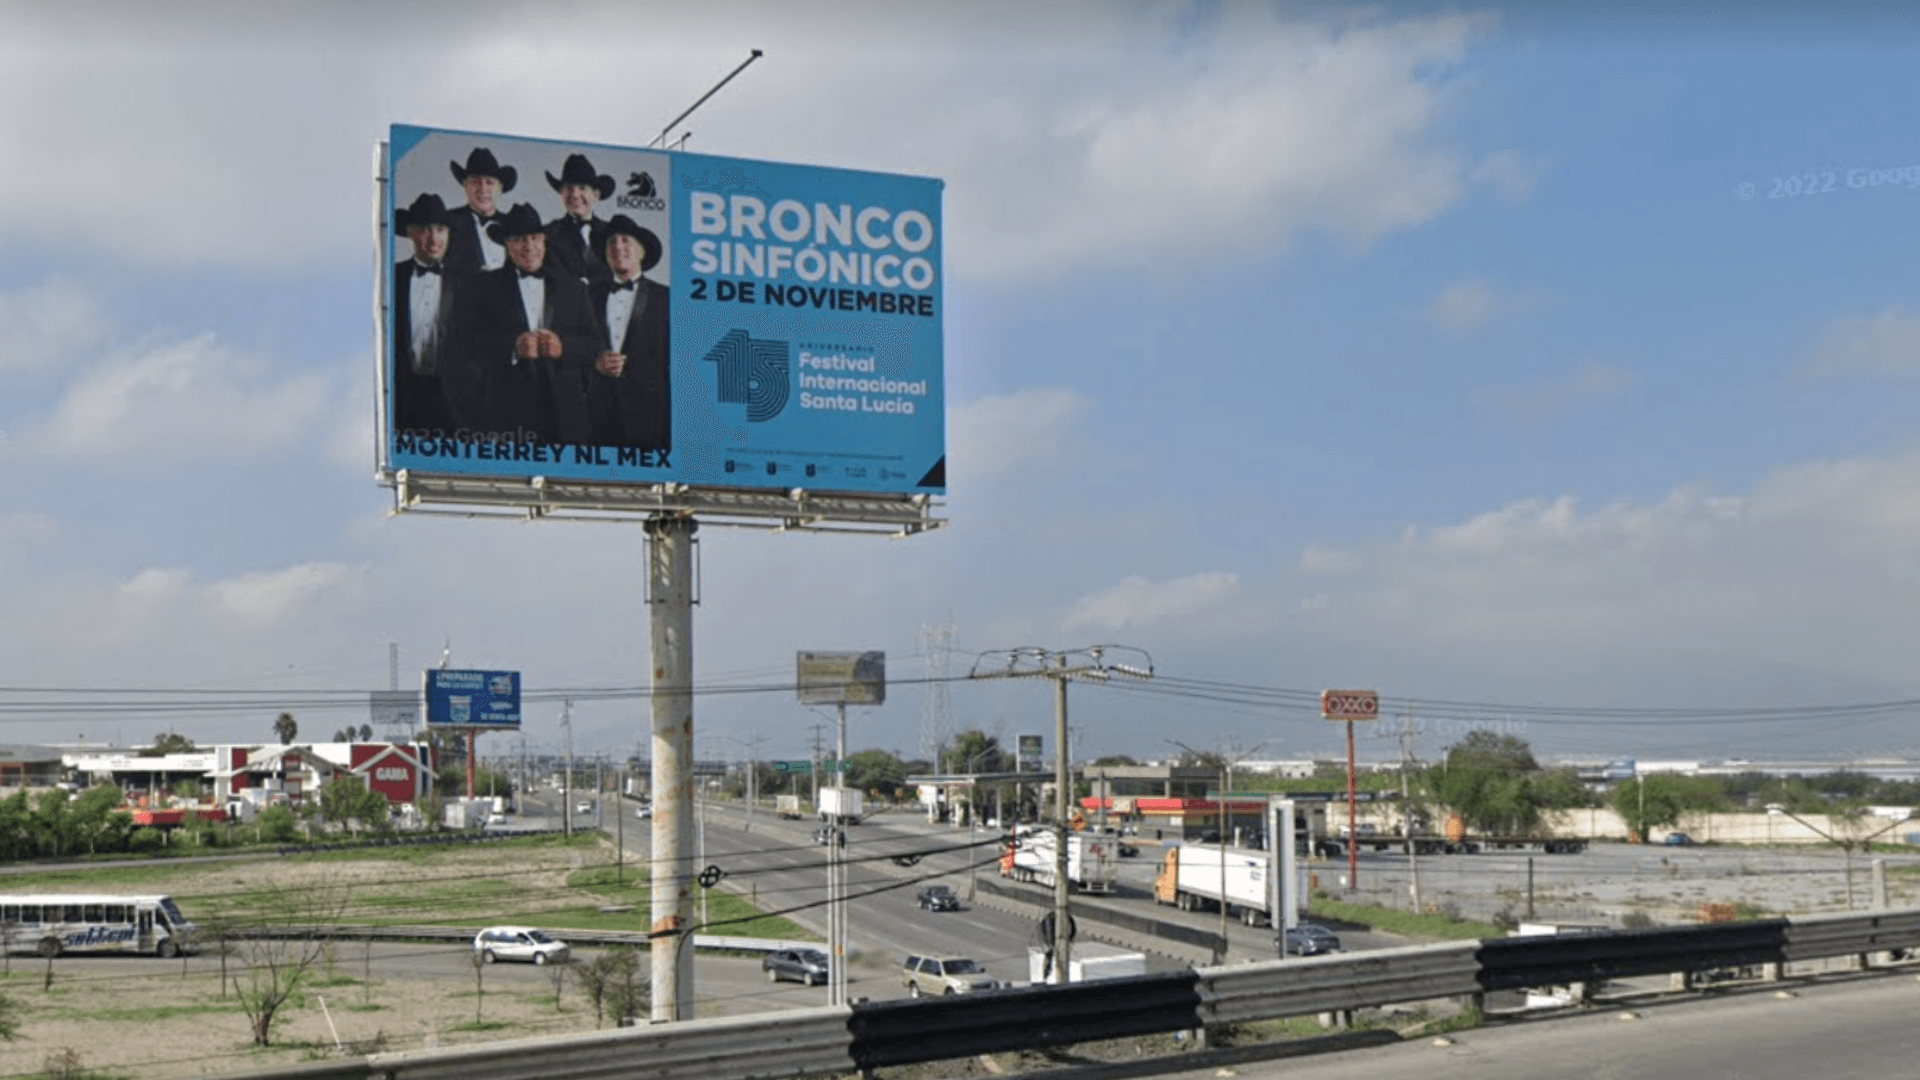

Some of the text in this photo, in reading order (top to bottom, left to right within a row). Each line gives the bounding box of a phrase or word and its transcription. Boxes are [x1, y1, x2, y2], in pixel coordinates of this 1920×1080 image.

[616, 195, 666, 211] BRONCO
[690, 190, 934, 253] BRONCO
[691, 240, 935, 291] SINFÓNICO
[690, 277, 935, 317] 2 DE NOVIEMBRE
[799, 351, 876, 374] Festival
[799, 371, 927, 396] Internacional
[800, 391, 916, 415] Santa Lucía
[395, 435, 672, 469] MONTERREY NL MEX
[1327, 695, 1377, 714] OXXO
[375, 766, 410, 781] GAMA
